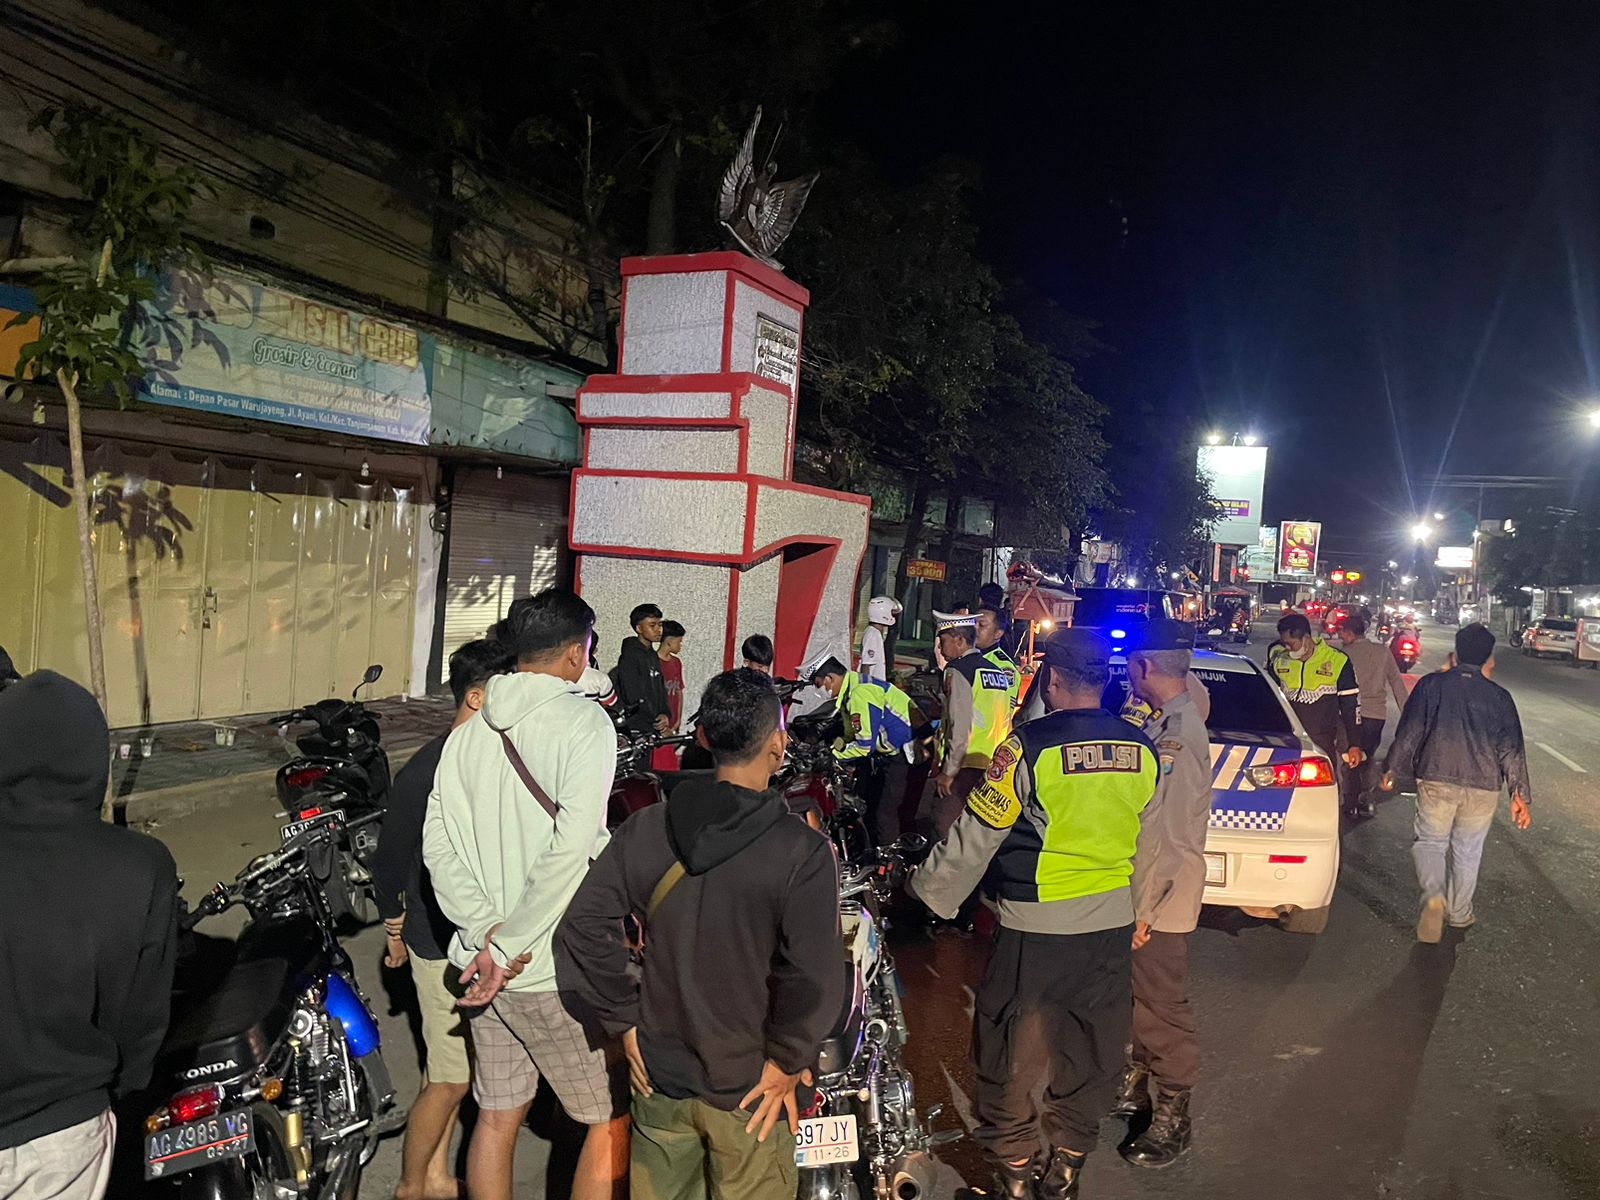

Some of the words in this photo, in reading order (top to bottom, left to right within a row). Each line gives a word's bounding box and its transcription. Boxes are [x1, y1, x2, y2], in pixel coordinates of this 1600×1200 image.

[253, 335, 297, 366] Grosir
[301, 349, 314, 369] &
[315, 352, 358, 380] Eceran
[188, 390, 215, 404] Depan
[217, 394, 239, 408] Pasar
[1066, 744, 1138, 771] POLISI
[285, 825, 298, 838] AG
[177, 1059, 238, 1079] ONDA
[149, 1134, 171, 1159] AG
[175, 1120, 219, 1150] 4985
[830, 1121, 848, 1142] JY
